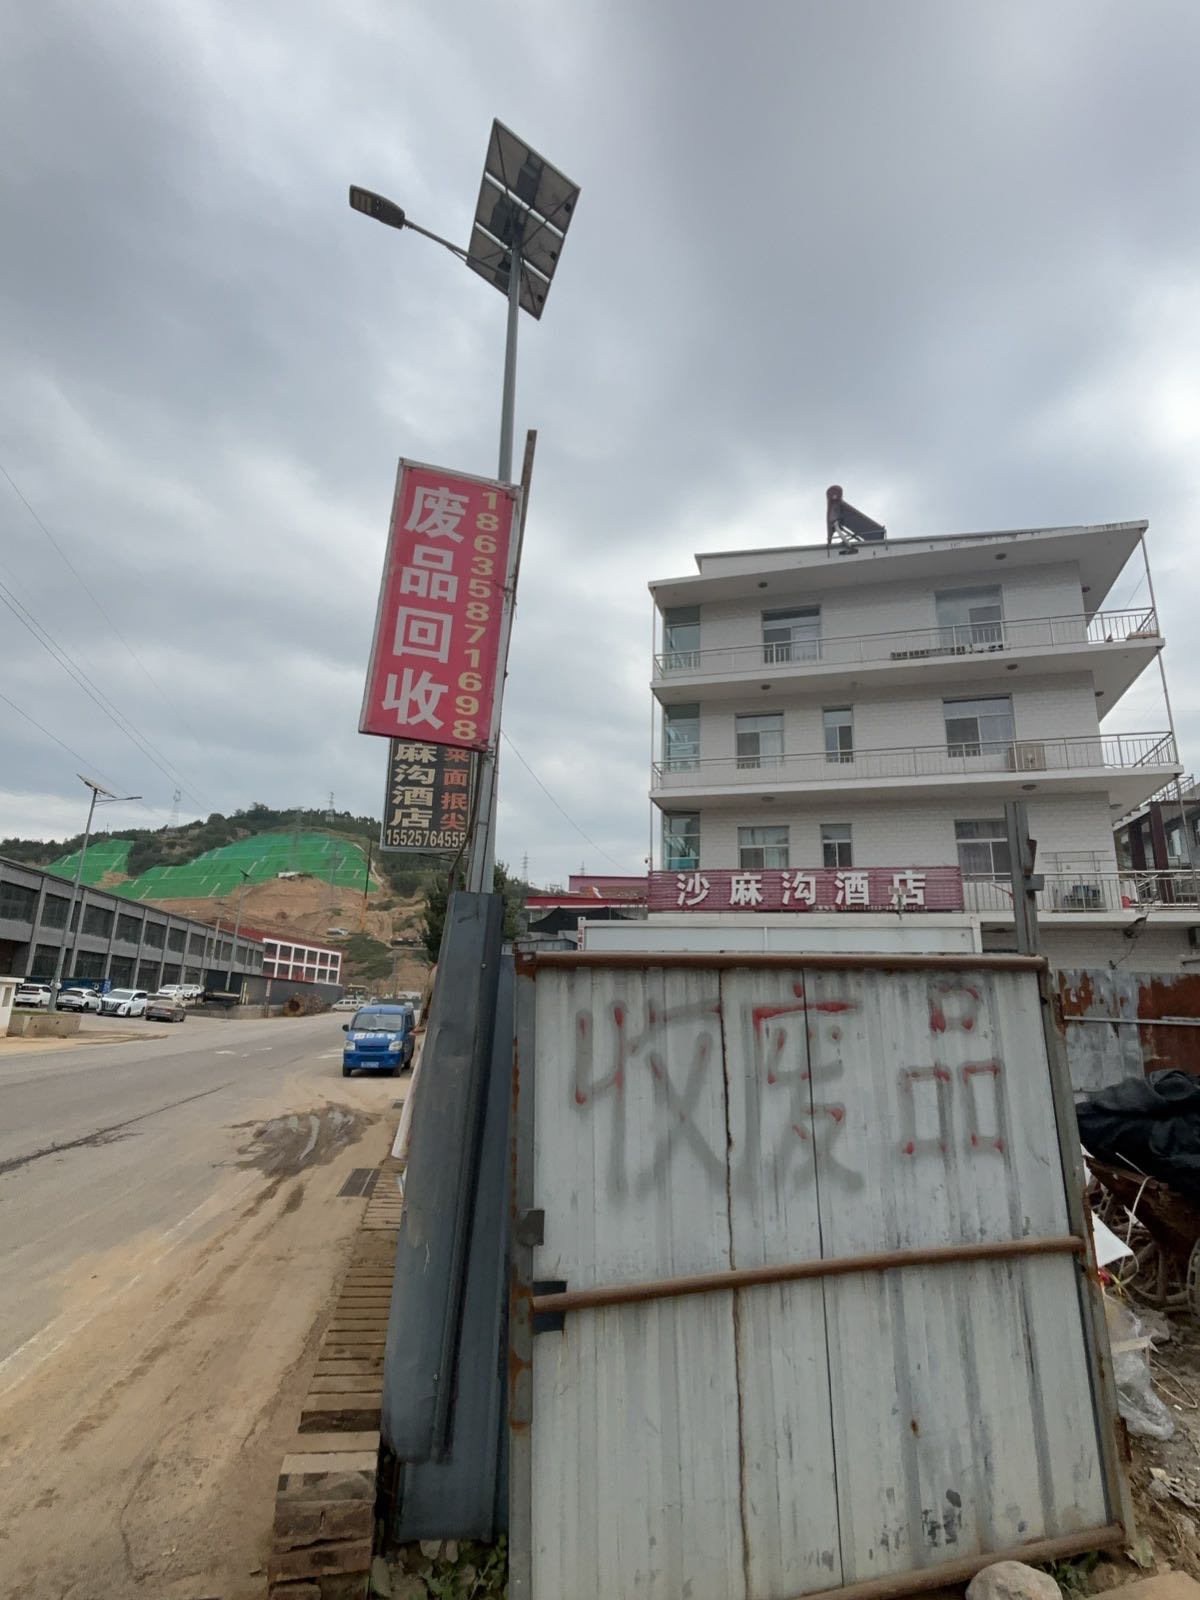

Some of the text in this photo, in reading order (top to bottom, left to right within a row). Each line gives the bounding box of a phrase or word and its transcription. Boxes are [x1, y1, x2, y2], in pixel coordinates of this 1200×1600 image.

[382, 485, 470, 730] 废品回收
[452, 491, 499, 741] 18635871698
[389, 743, 438, 828] 麻沟酒店
[676, 870, 926, 906] 沙麻沟酒店
